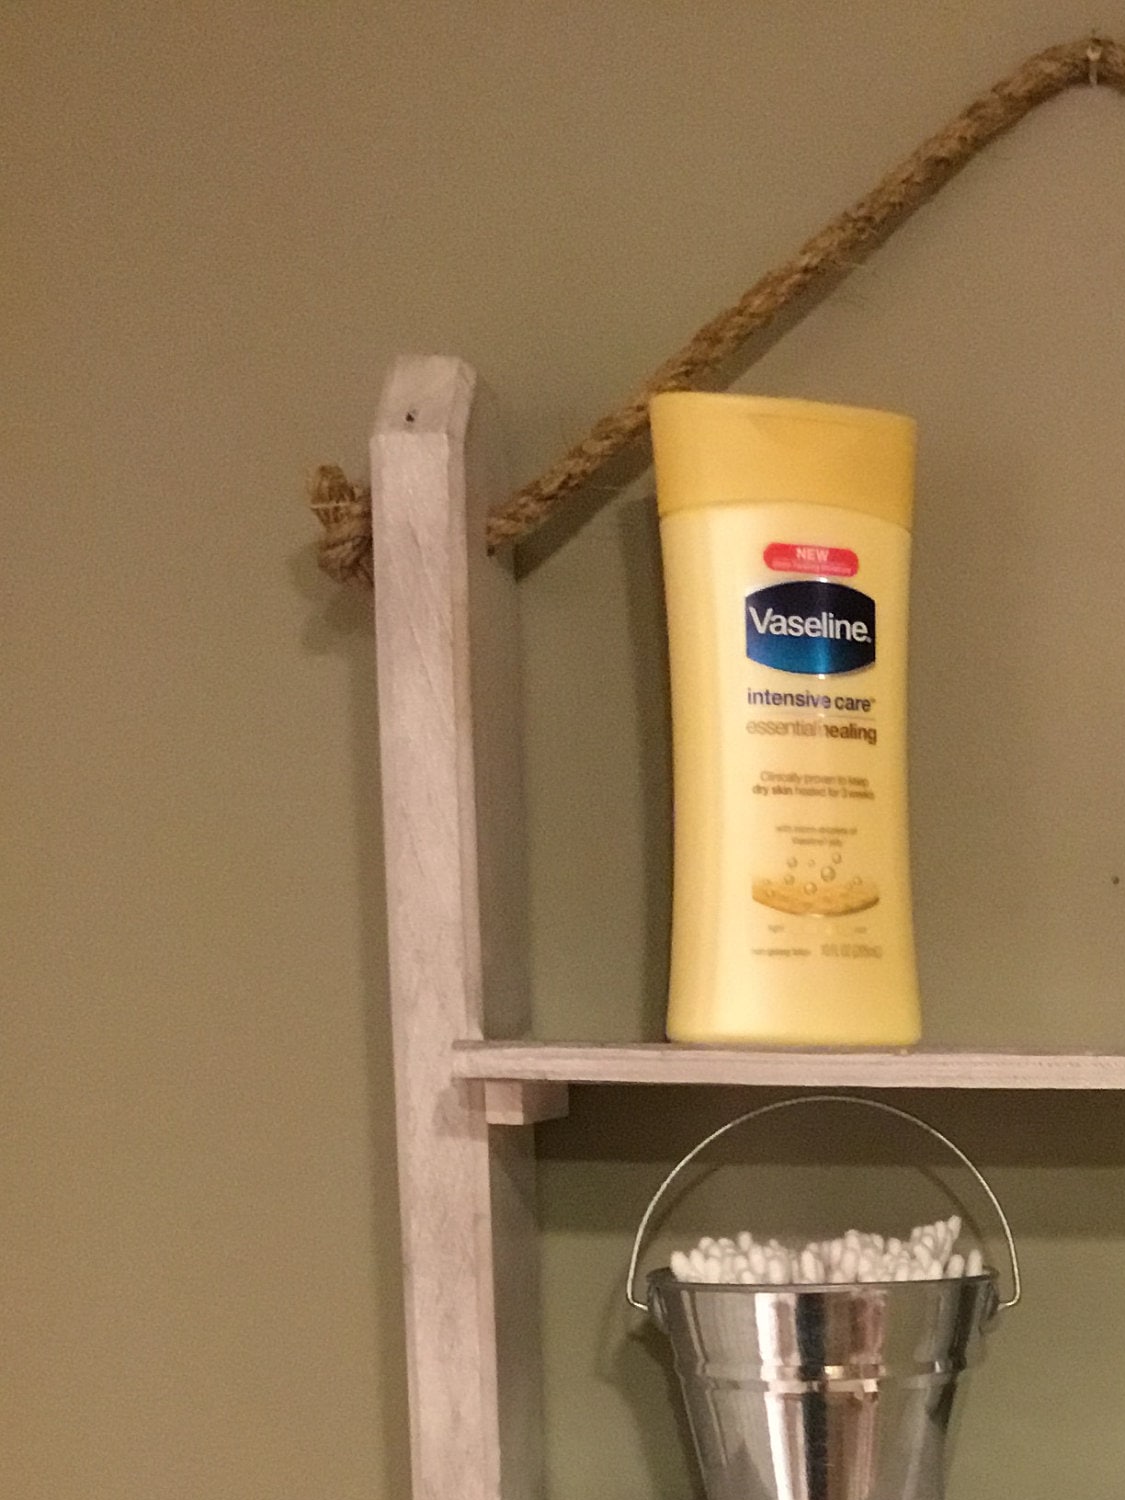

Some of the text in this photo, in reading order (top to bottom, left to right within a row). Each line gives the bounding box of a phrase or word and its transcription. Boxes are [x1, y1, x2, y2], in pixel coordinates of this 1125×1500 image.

[795, 546, 830, 561] NEW
[748, 606, 872, 642] Vaseline
[746, 688, 871, 713] intensive care
[745, 720, 817, 737] essential
[751, 784, 768, 796] dry
[771, 785, 793, 795] skin
